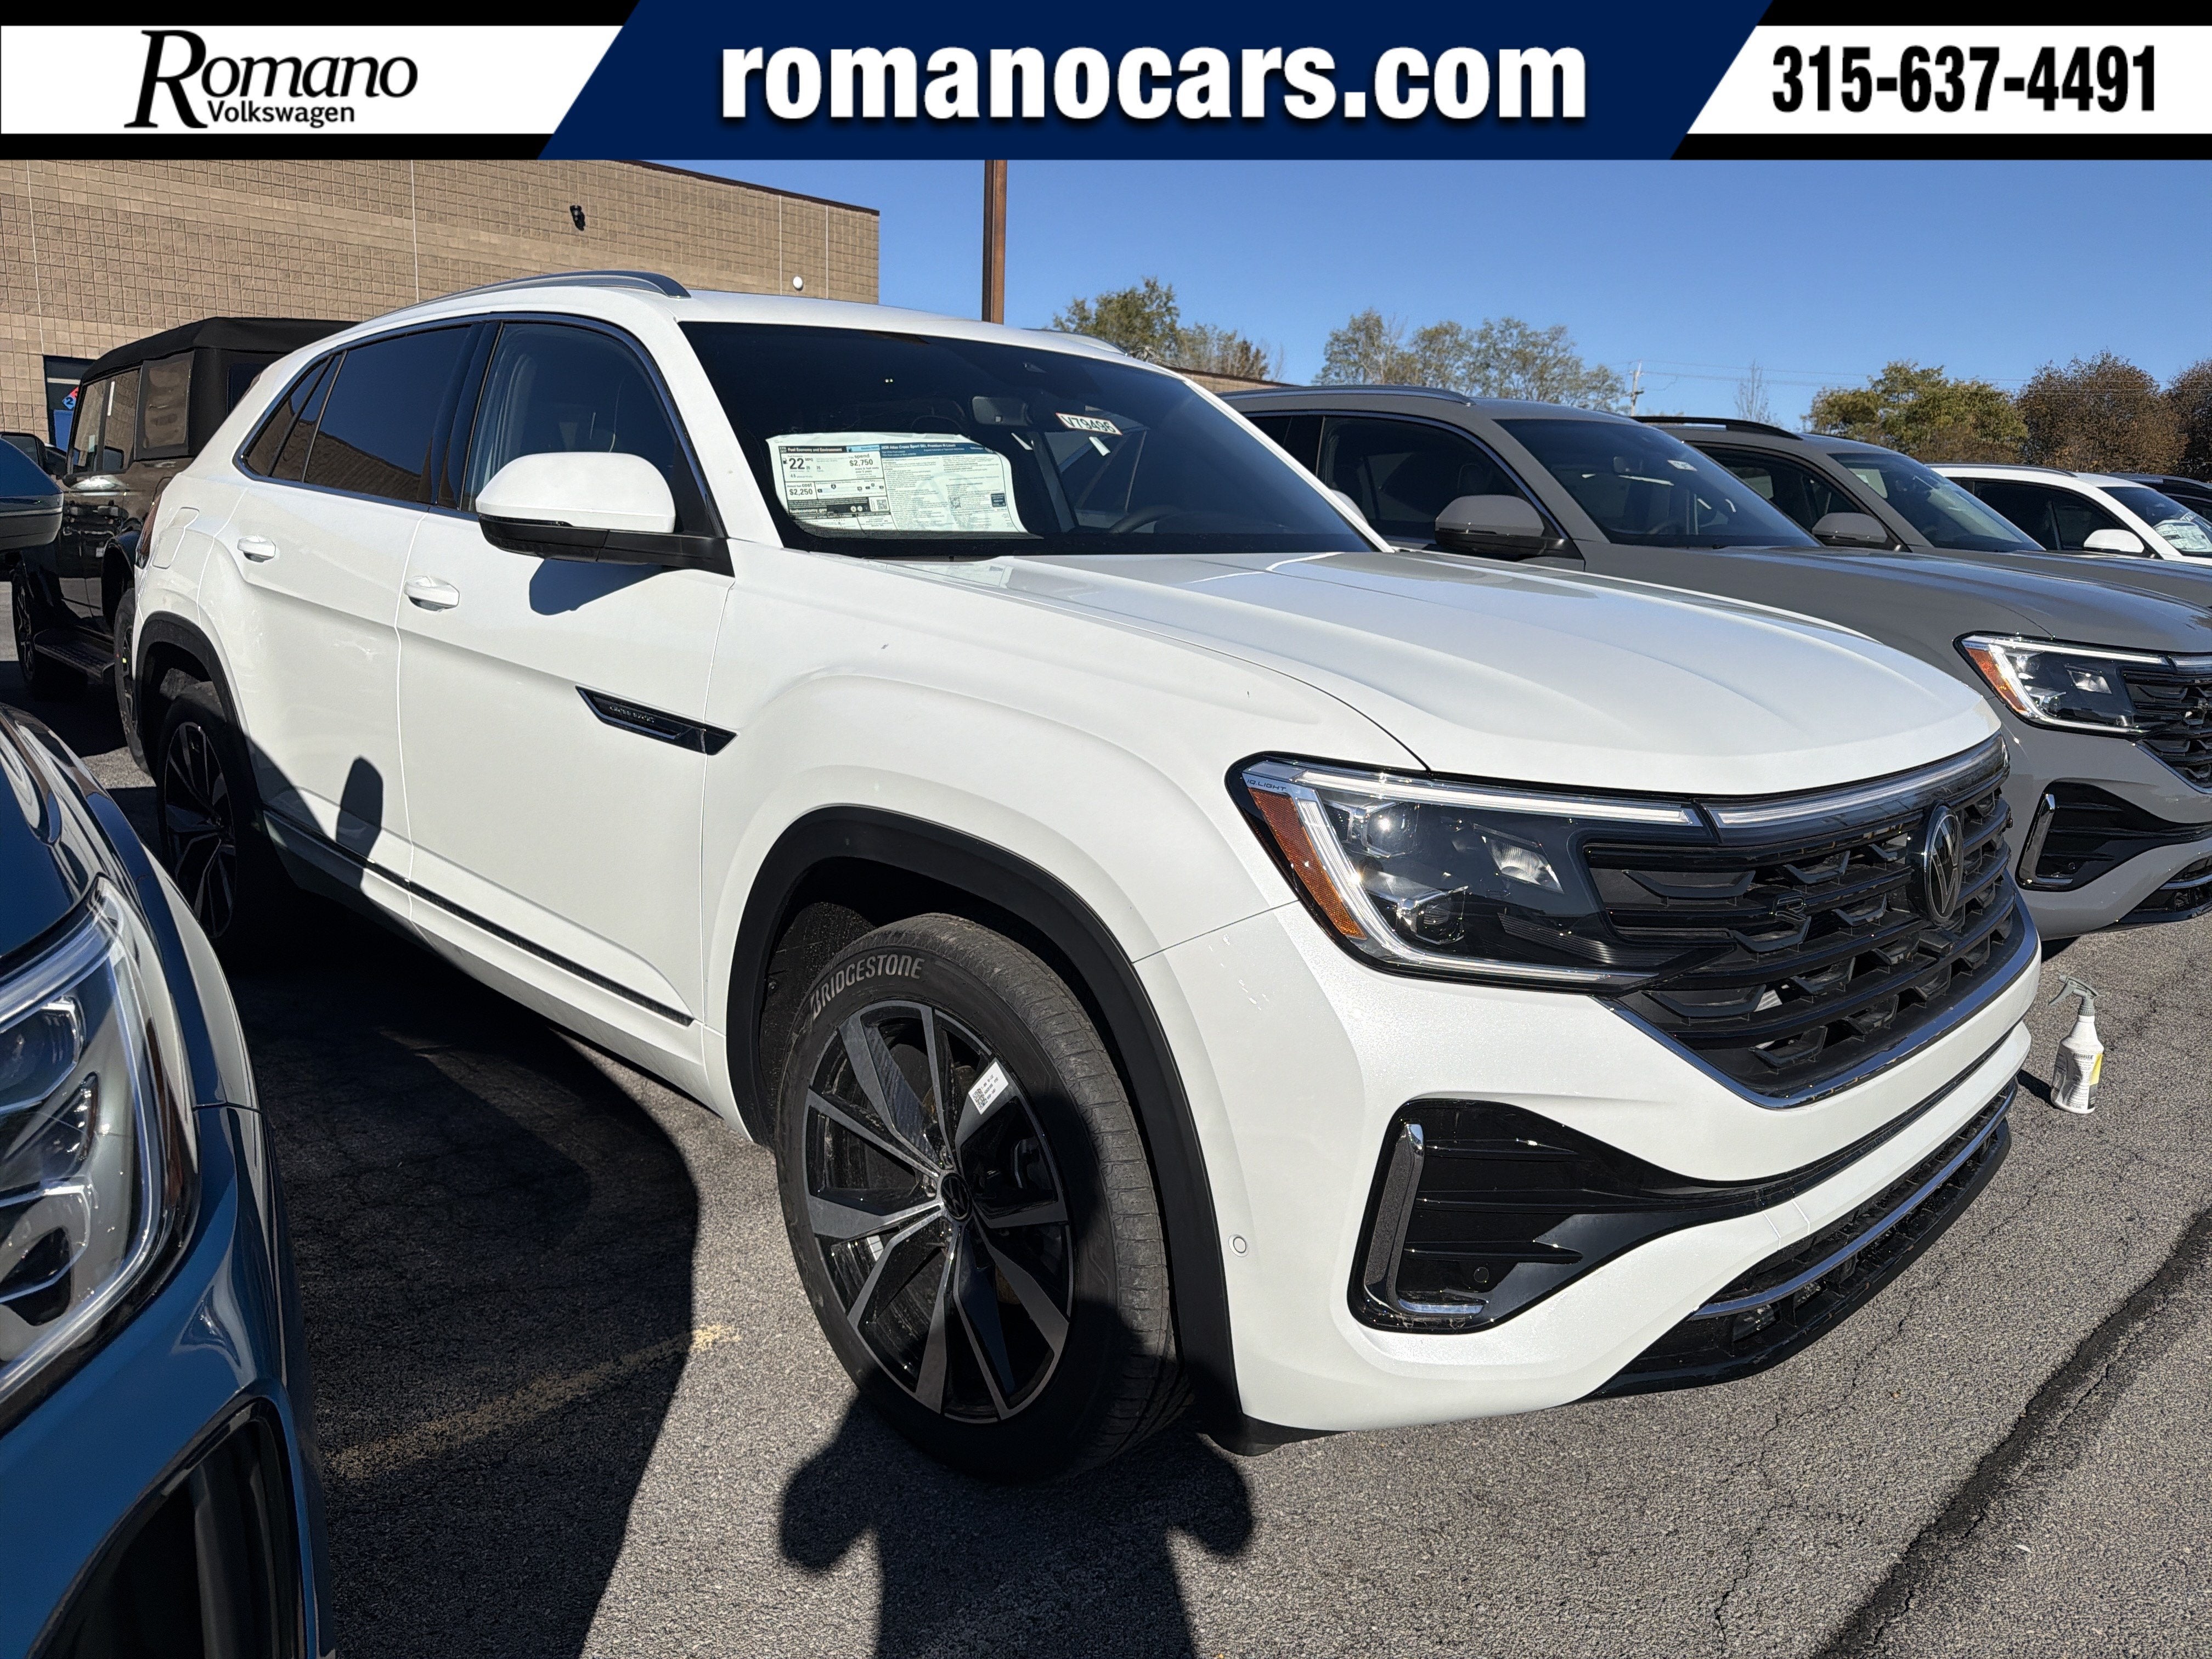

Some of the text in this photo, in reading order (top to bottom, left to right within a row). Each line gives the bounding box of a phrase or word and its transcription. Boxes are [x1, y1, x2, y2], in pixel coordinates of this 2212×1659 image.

[66, 397, 74, 405] 2
[1060, 415, 1116, 433] V79496
[788, 458, 805, 470] 22
[1246, 778, 1286, 792] IQ.LIGHT
[810, 953, 926, 1022] BRIDGESTONE
